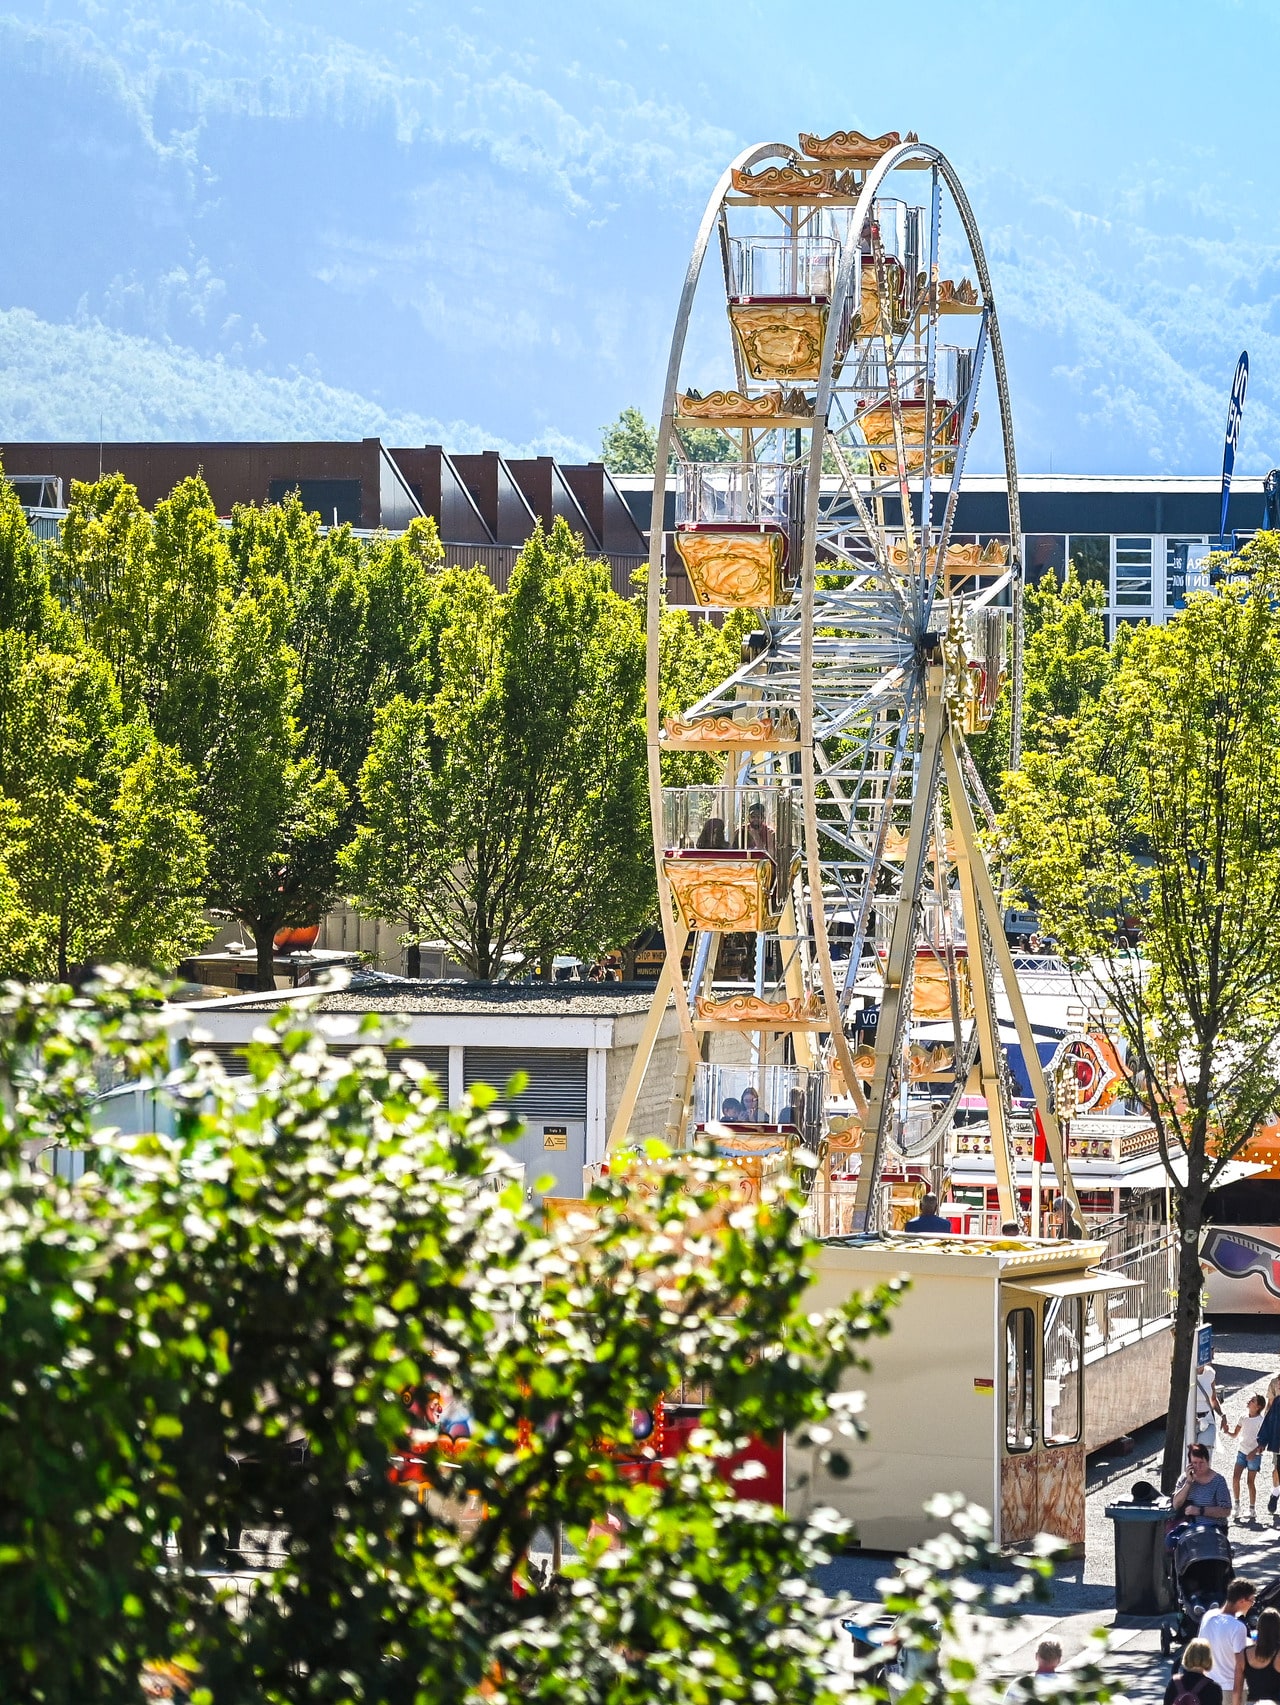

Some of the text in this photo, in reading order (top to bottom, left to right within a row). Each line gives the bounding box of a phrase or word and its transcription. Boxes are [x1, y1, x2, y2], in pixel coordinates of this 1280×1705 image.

[753, 363, 763, 375] 4
[878, 462, 888, 472] 6
[701, 592, 711, 603] 3
[688, 918, 698, 928] 2
[862, 1012, 877, 1025] VO
